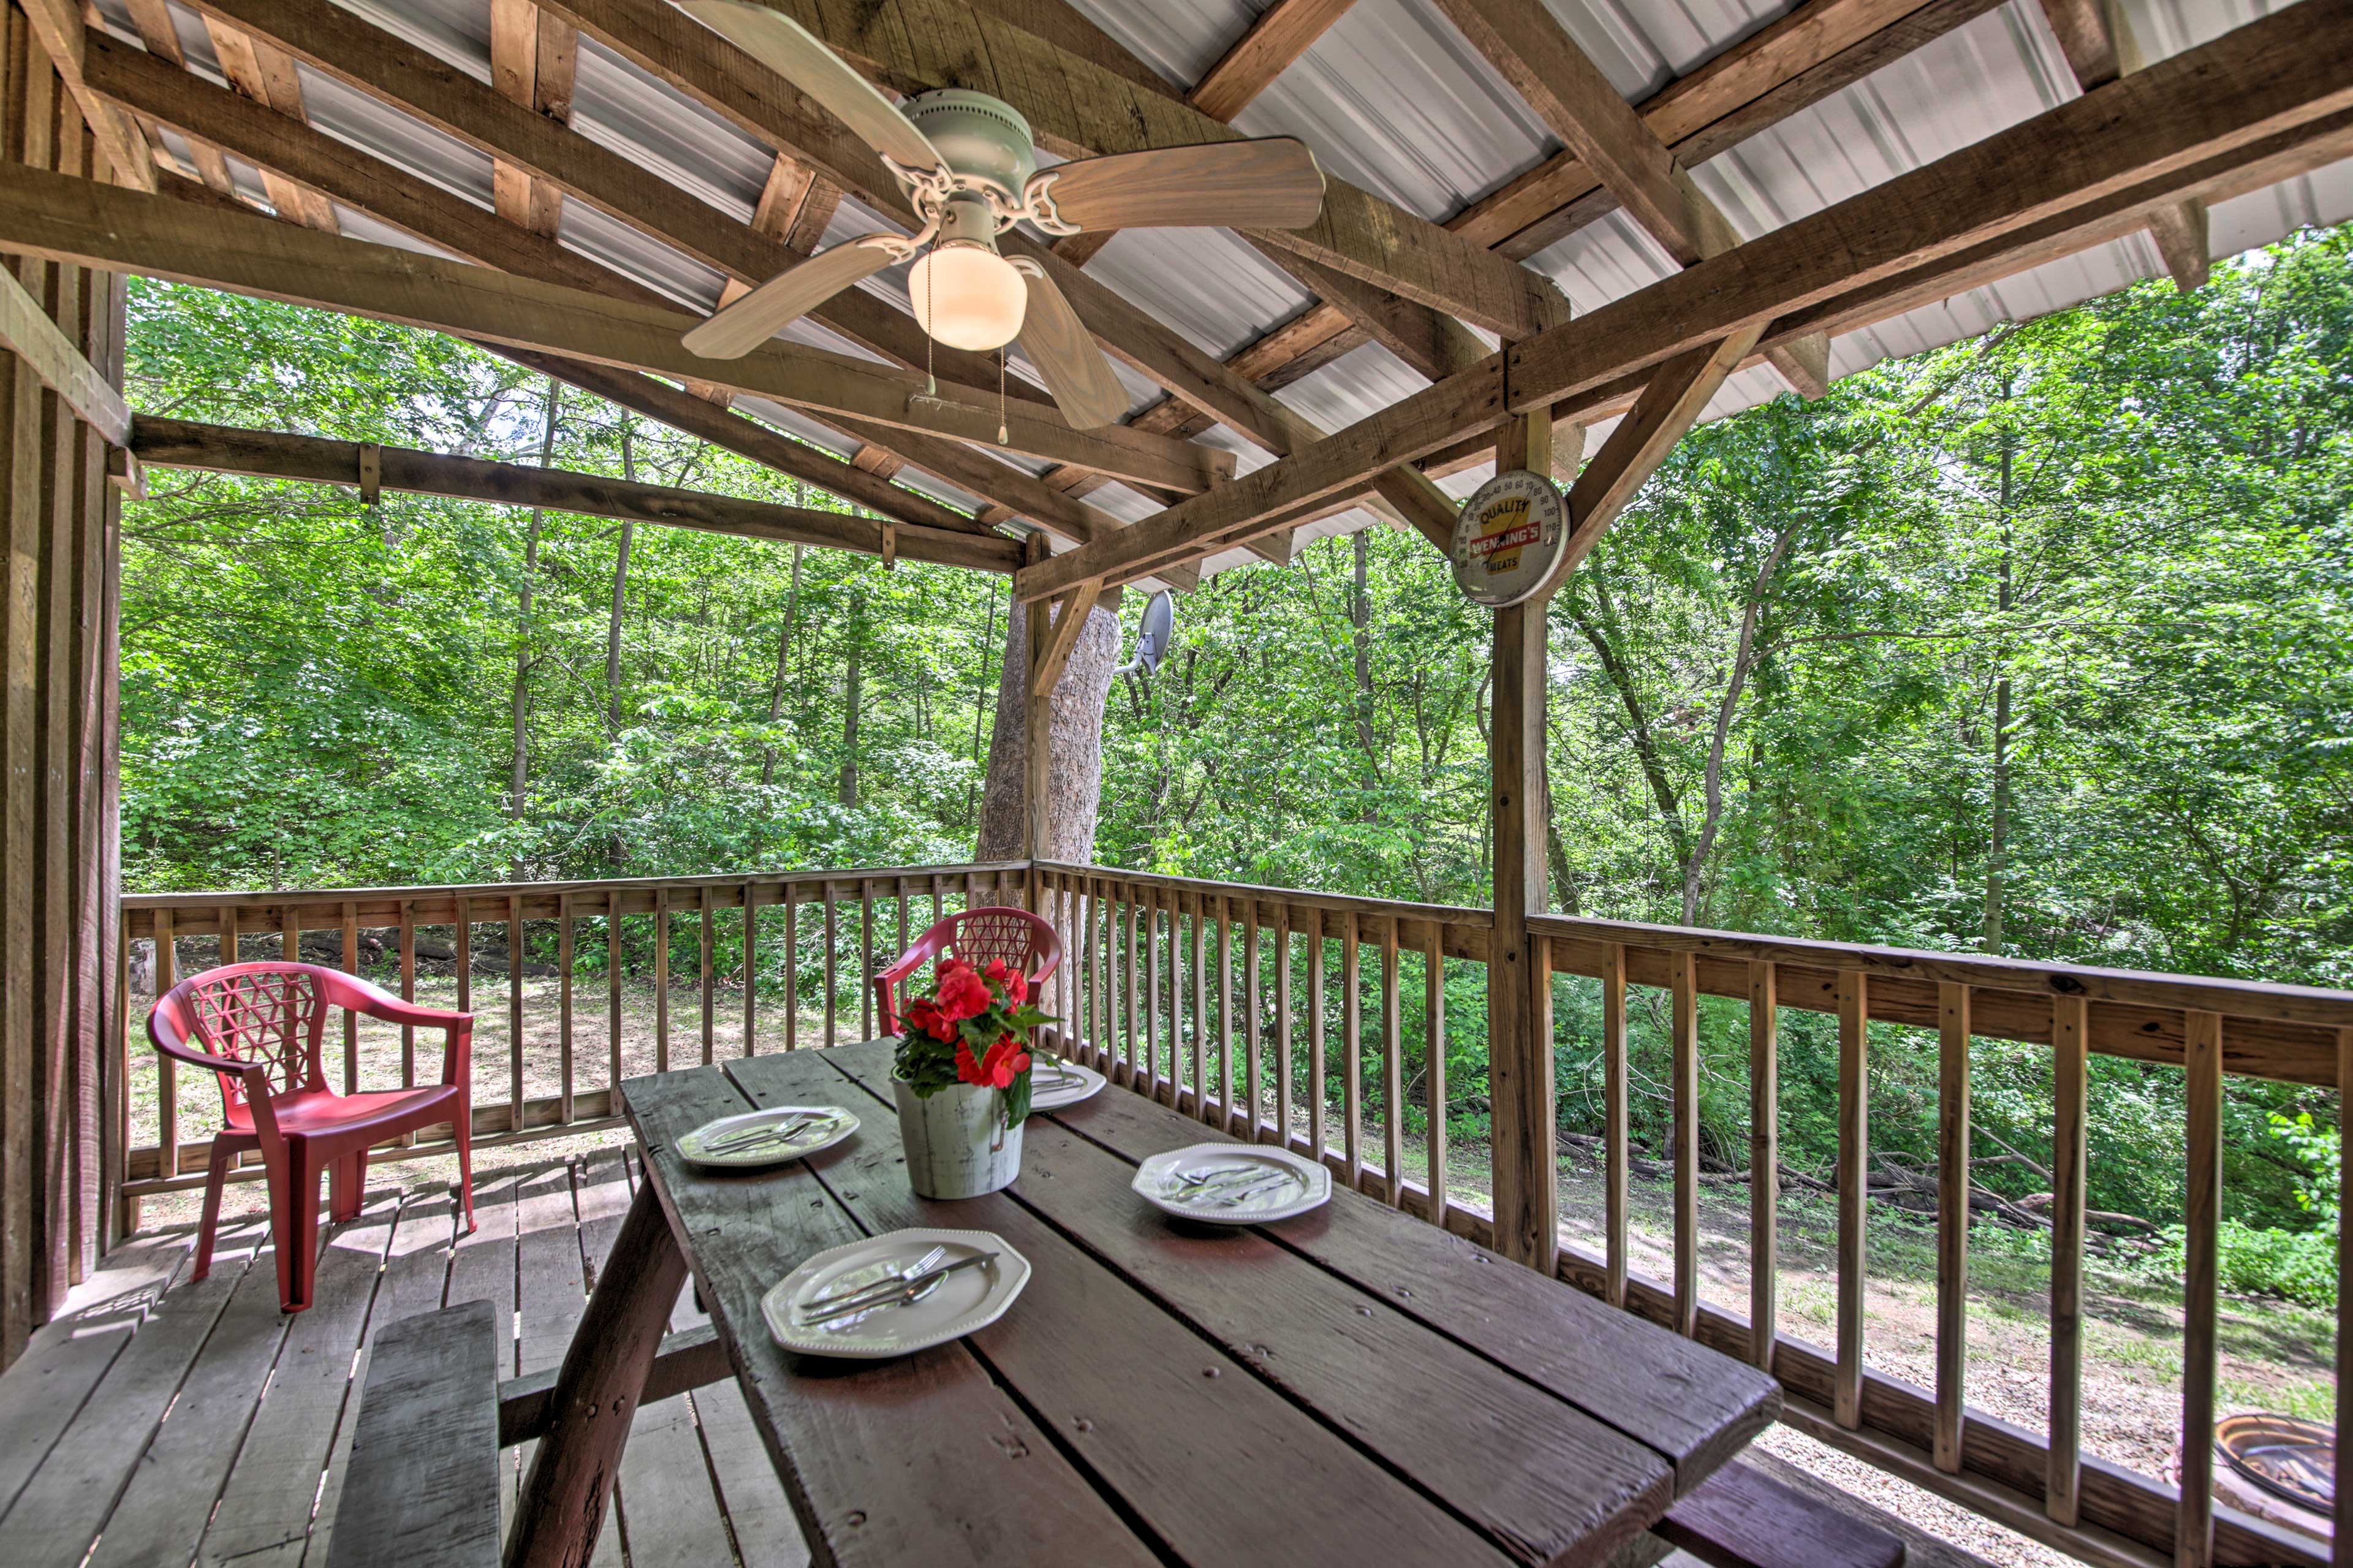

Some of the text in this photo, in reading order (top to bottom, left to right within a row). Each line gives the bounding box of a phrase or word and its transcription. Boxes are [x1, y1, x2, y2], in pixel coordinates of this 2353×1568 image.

[1504, 482, 1512, 490] 50
[1515, 480, 1523, 489] 60
[1526, 482, 1533, 490] 70
[1534, 487, 1542, 496] 80
[1540, 496, 1548, 505] 90
[1480, 499, 1529, 525] QUALITY
[1544, 507, 1555, 517] 100
[1546, 523, 1556, 532] 110
[1490, 558, 1517, 572] MEATS
